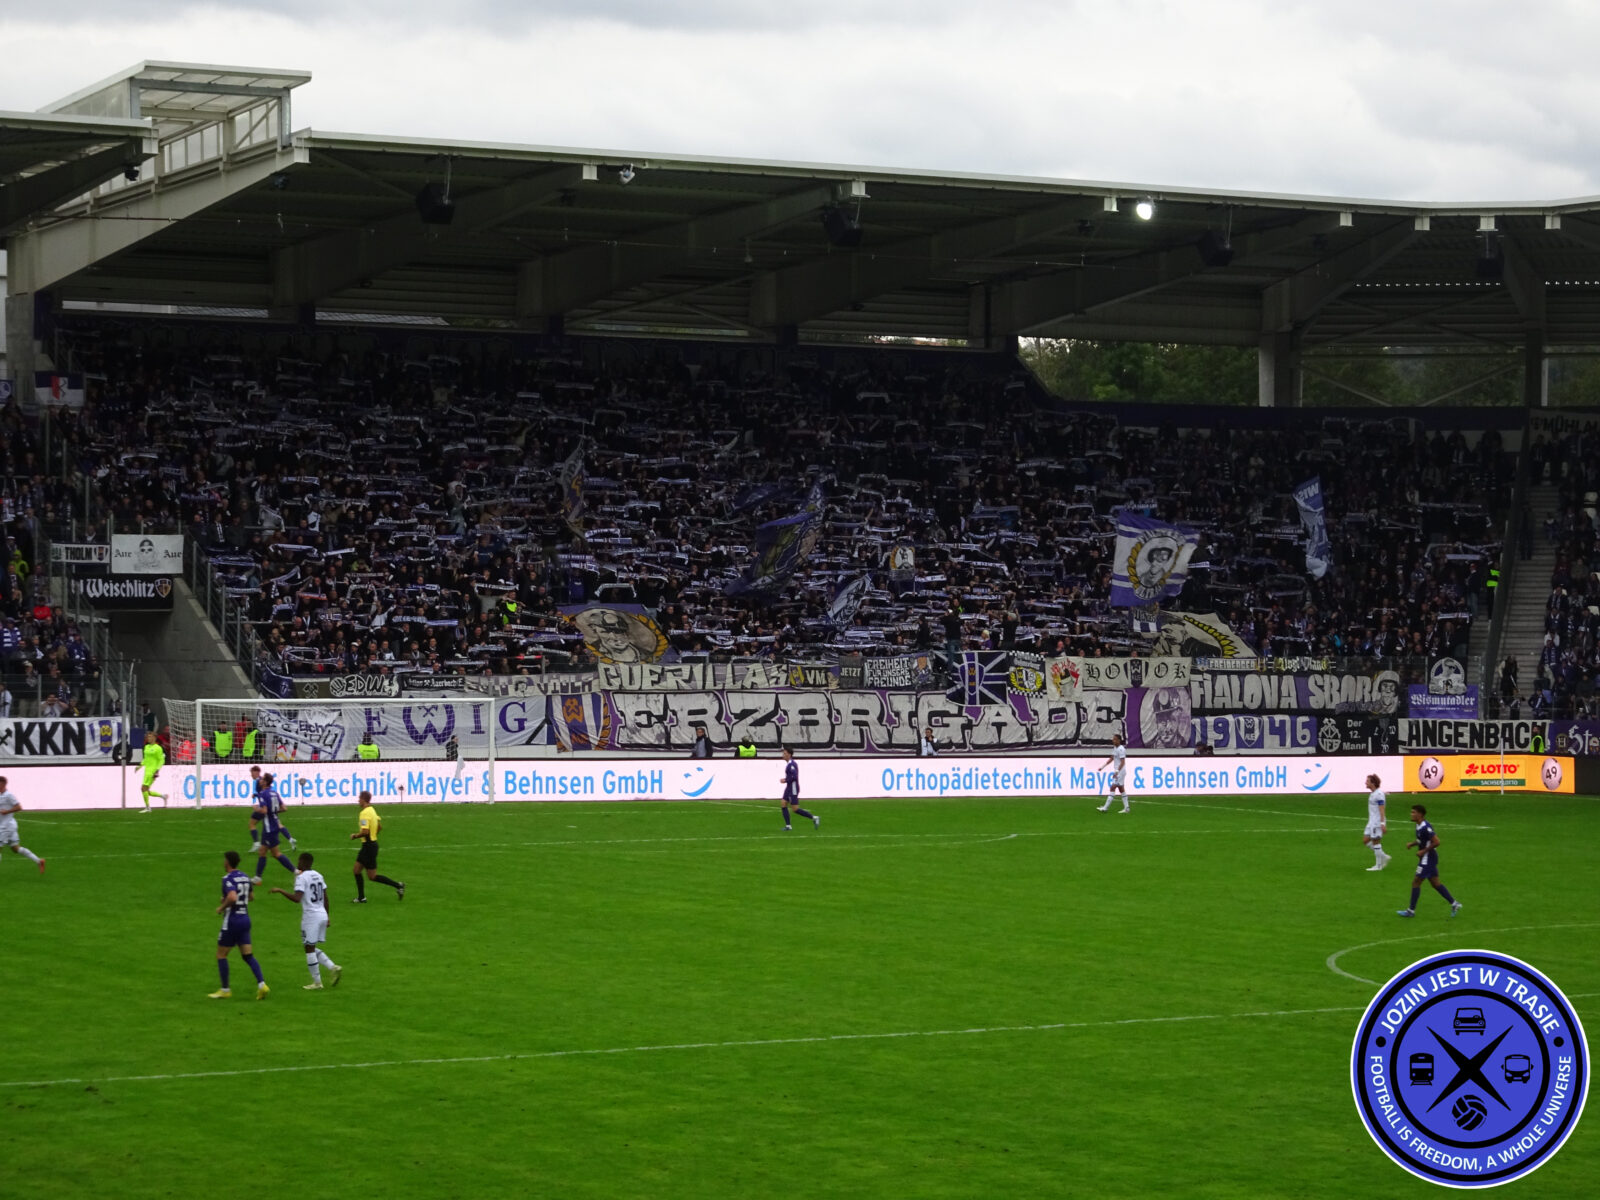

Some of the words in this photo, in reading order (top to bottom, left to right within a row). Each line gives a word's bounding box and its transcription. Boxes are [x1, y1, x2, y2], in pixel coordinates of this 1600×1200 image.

[86, 578, 155, 598] Weischlitz
[866, 657, 910, 670] FREIHEIT
[600, 662, 788, 690] GUERILLAS
[805, 669, 827, 685] VM
[840, 667, 862, 677] JETZT
[867, 675, 912, 688] FREUNDE
[611, 690, 1128, 748] ERZBRIGADE
[1346, 719, 1363, 728] Der
[13, 721, 87, 755] KKN
[1348, 730, 1361, 738] 12.
[1397, 719, 1547, 749] ANGENBACH
[1342, 742, 1367, 751] Mann
[1424, 765, 1439, 780] 49
[1481, 764, 1517, 774] LOTTO
[1545, 766, 1558, 780] 49
[407, 771, 473, 802] Mayer
[504, 770, 595, 795] Behnsen
[602, 769, 663, 795] GmbH
[881, 767, 1062, 795] Orthopädietechnik
[1070, 767, 1116, 795] Maye
[1133, 766, 1146, 789] &
[1152, 766, 1229, 789] Behnsen
[1235, 765, 1287, 789] GmbH
[309, 881, 324, 903] 30
